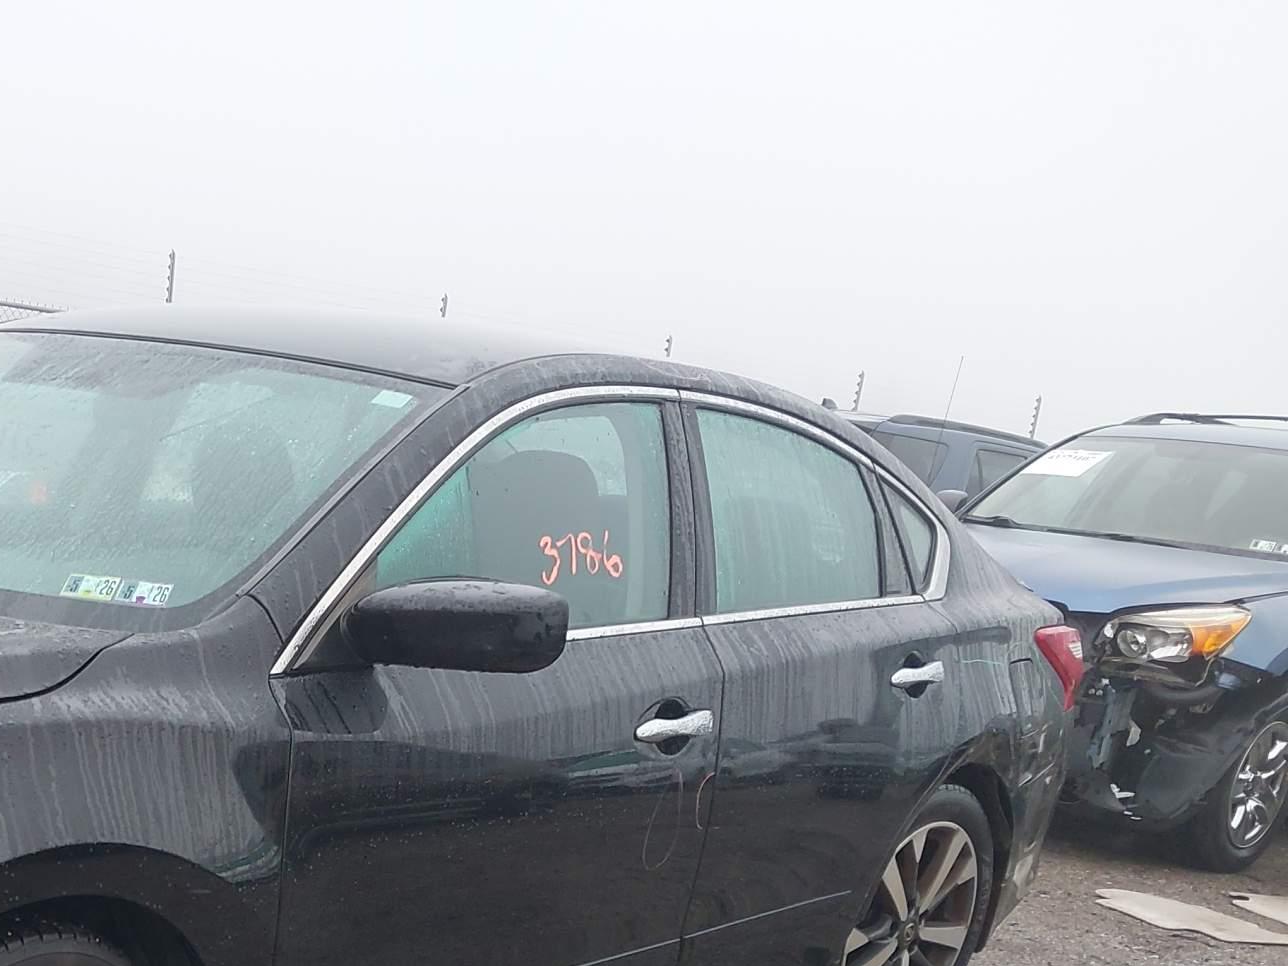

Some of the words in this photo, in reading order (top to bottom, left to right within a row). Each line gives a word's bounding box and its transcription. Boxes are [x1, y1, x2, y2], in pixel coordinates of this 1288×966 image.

[539, 529, 623, 585] 3786
[99, 579, 116, 596] 26
[152, 586, 169, 603] 26
